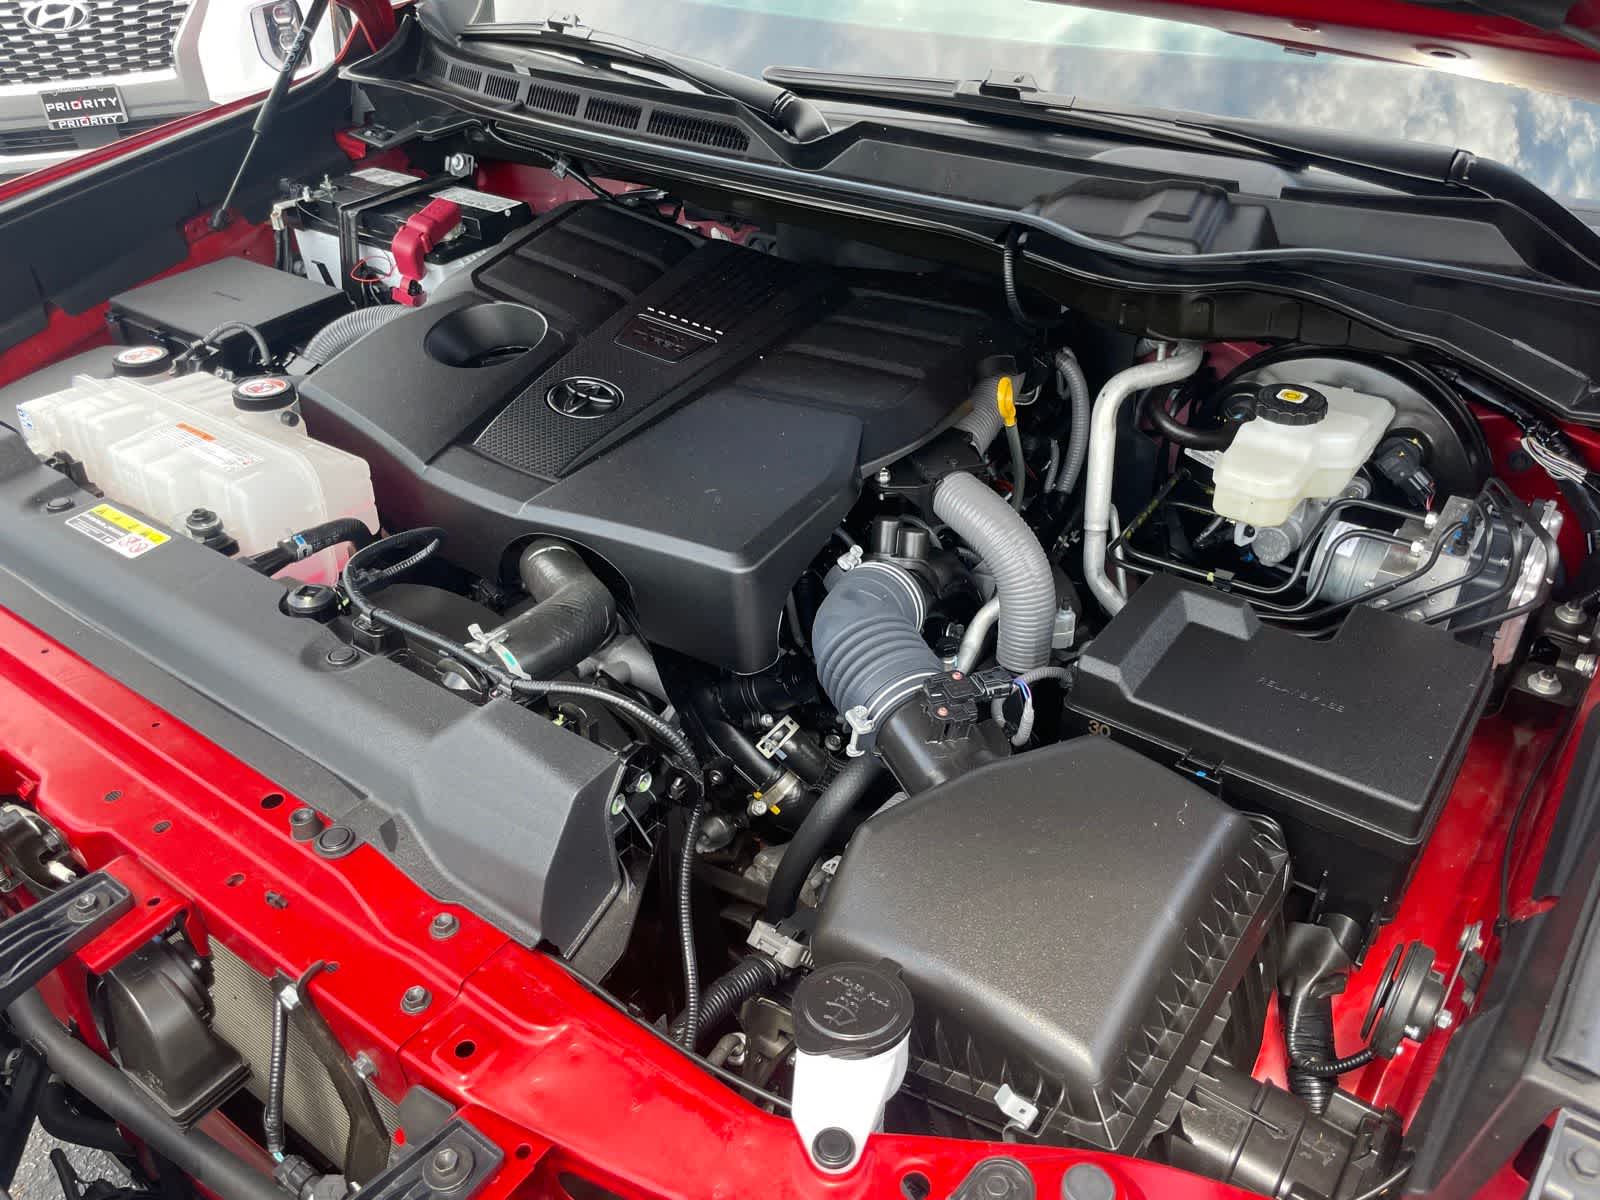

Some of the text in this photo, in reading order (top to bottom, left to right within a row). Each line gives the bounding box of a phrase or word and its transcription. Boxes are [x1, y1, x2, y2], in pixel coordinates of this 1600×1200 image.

[45, 96, 118, 113] PRIORITY
[58, 114, 118, 129] PRIORITY
[1088, 720, 1112, 738] 30
